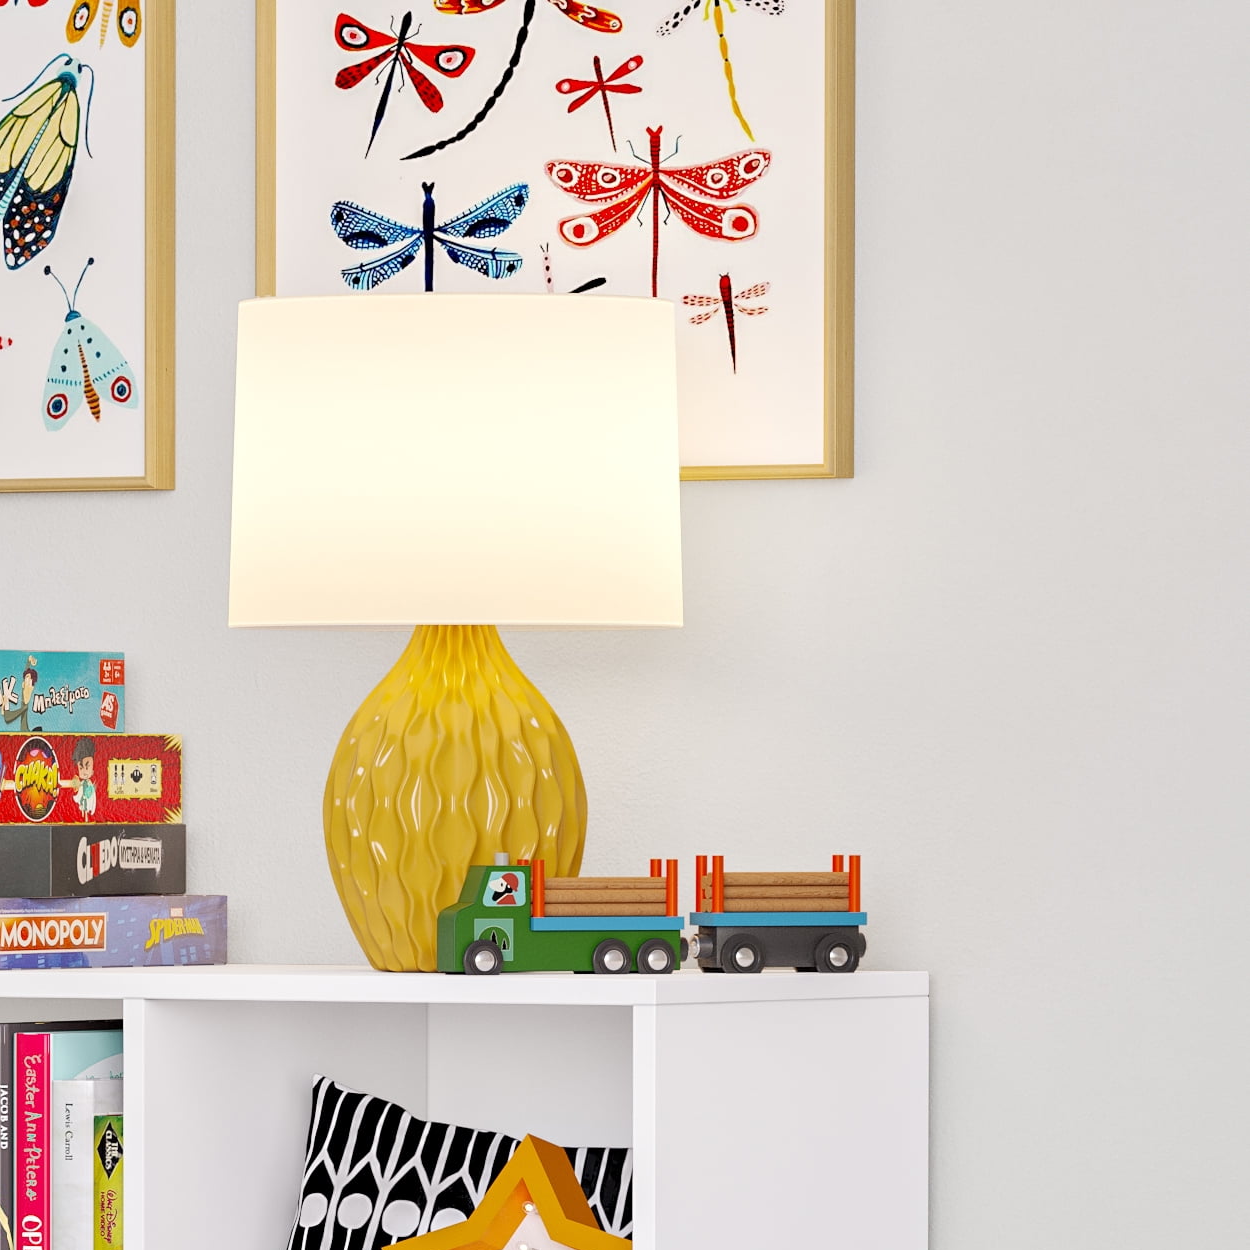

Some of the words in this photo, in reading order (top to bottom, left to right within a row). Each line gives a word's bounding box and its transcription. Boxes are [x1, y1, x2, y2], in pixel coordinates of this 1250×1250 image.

[101, 694, 115, 712] AS
[15, 760, 58, 798] CHAKA!
[0, 919, 104, 948] MONOPOLY
[24, 1054, 42, 1109] Easter
[0, 1085, 8, 1122] JACOB
[65, 1103, 73, 1128] Lewis
[0, 1125, 8, 1150] AND
[65, 1130, 73, 1160] Carroll
[111, 1141, 119, 1157] THE
